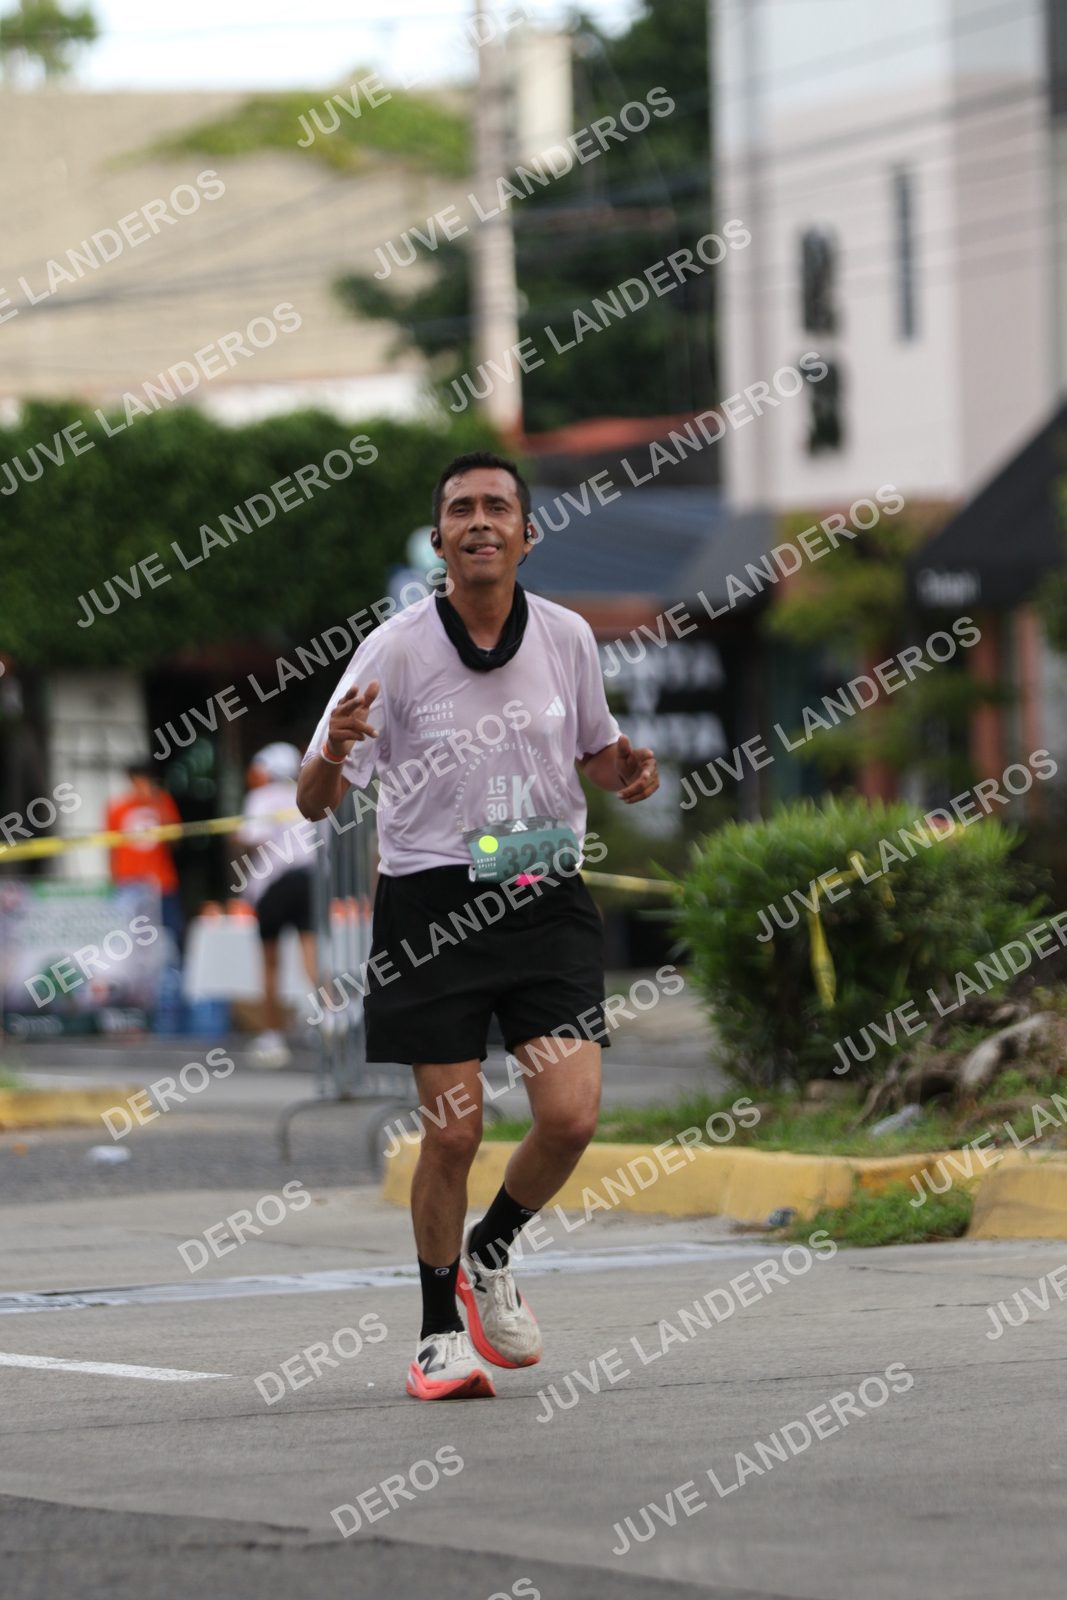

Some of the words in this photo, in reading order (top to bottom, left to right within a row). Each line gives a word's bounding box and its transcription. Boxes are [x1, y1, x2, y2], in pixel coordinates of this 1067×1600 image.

[487, 776, 507, 794] 15
[512, 773, 537, 819] K
[487, 803, 508, 822] 30
